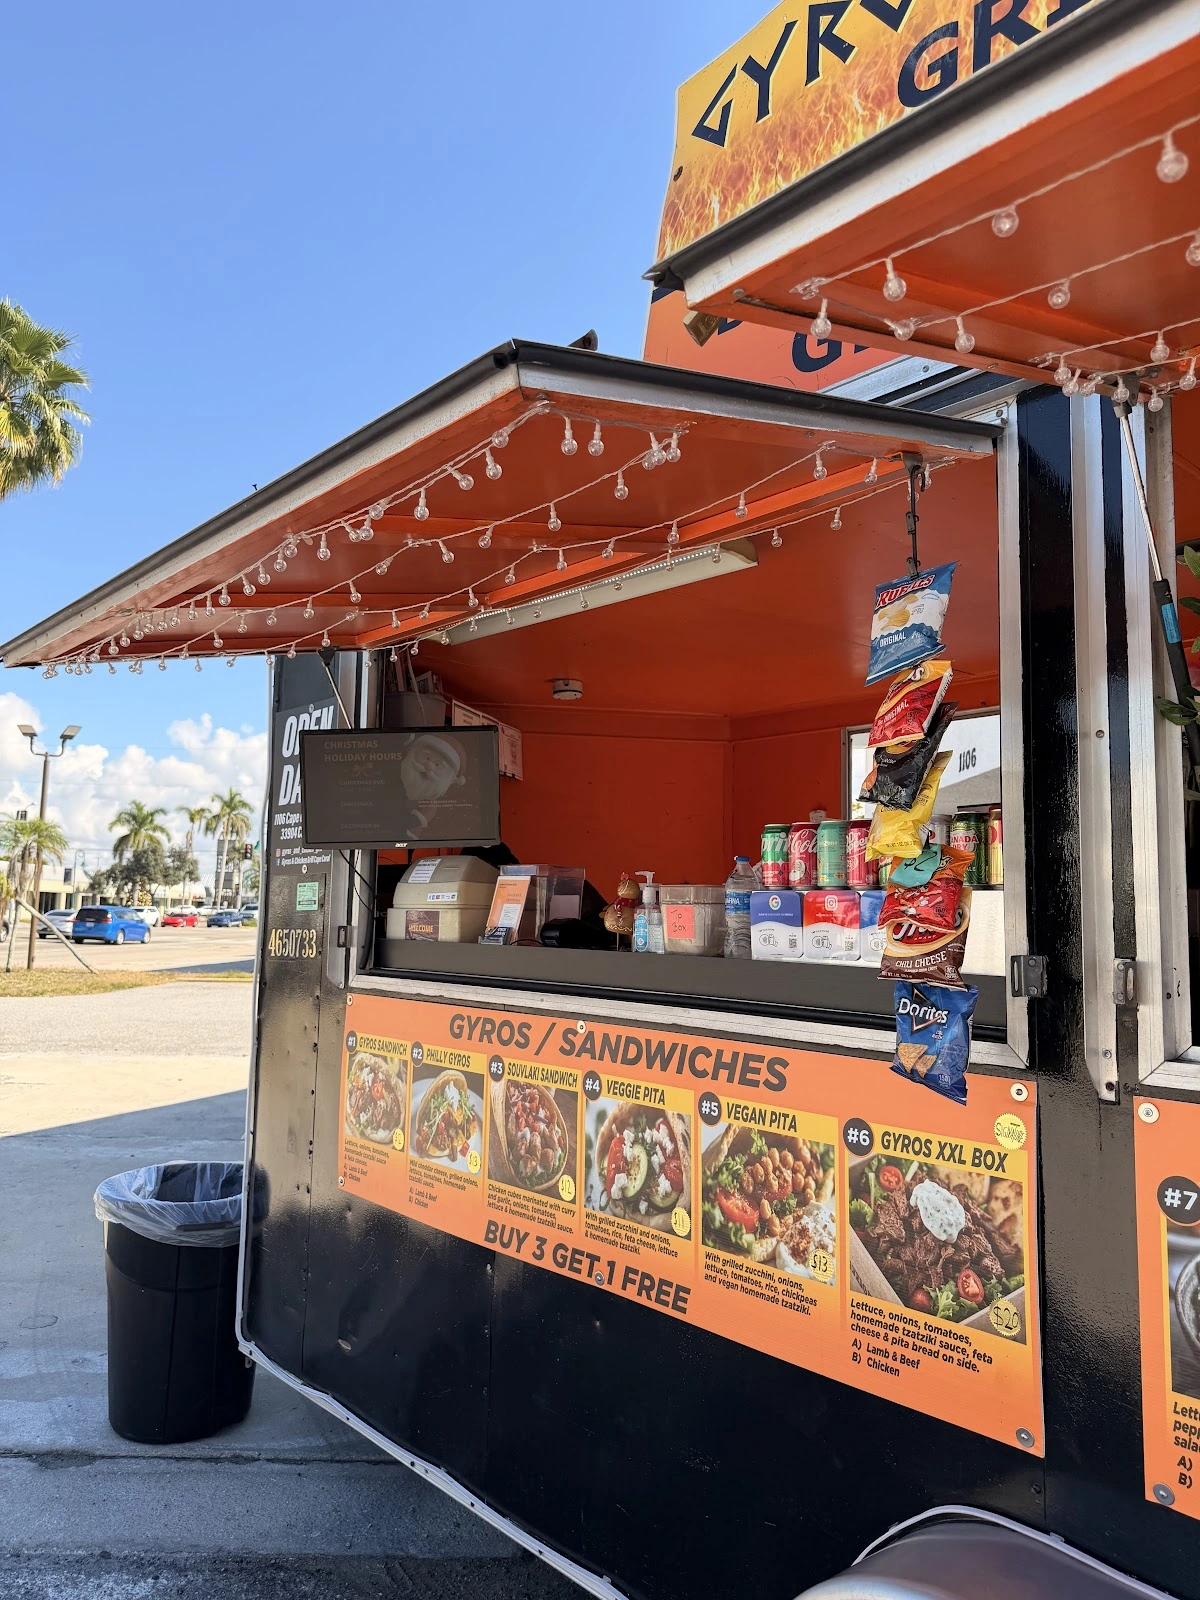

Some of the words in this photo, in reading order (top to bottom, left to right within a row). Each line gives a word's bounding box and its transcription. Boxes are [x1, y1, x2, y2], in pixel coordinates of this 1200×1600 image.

[898, 0, 1093, 108] GR
[879, 632, 906, 647] ORIGINAL
[324, 740, 379, 749] CHRISTMAS
[324, 753, 368, 762] HOLIDAY
[369, 752, 402, 761] HOURS
[959, 747, 977, 773] 1106
[268, 928, 317, 958] 4650733
[896, 959, 913, 968] CHILI
[915, 951, 947, 968] CHEESE
[899, 998, 948, 1023] Doritos
[348, 1036, 356, 1047] #1
[359, 1036, 377, 1050] GYROS
[377, 1040, 408, 1056] SANDWICH
[412, 1048, 423, 1060] #2
[426, 1048, 448, 1063] PHILLY
[448, 1053, 471, 1068] GYROS
[449, 1013, 532, 1049] GYROS
[533, 1022, 556, 1055] /
[558, 1027, 790, 1092] SANDWICHES
[490, 1061, 503, 1075] #3
[507, 1062, 540, 1080] SOUVLAKI
[540, 1068, 578, 1088] SANDWICH
[585, 1077, 600, 1092] #4
[606, 1079, 641, 1100] VEGGIE
[642, 1086, 666, 1105] PITA
[701, 1098, 719, 1117] #5
[726, 1101, 768, 1128] VEGAN
[769, 1110, 798, 1133] PITA
[847, 1127, 870, 1146] #6
[880, 1130, 933, 1159] GYROS
[935, 1139, 967, 1165] XXL
[971, 1147, 1009, 1173] BOX
[409, 1160, 417, 1169] Mild
[448, 1171, 463, 1183] grilled
[463, 1177, 479, 1188] onions,
[409, 1166, 423, 1178] lettuce,
[424, 1172, 443, 1185] tomatoes,
[443, 1178, 466, 1191] homemade
[560, 1178, 573, 1195] $12
[414, 1198, 428, 1208] Chicken
[415, 1188, 425, 1198] Lamb
[428, 1193, 438, 1203] Beef
[488, 1183, 507, 1195] Chicken
[507, 1189, 521, 1200] cubes
[522, 1194, 549, 1208] marinated
[549, 1202, 561, 1212] with
[561, 1207, 576, 1217] curry
[488, 1192, 498, 1200] and
[498, 1196, 511, 1206] garlic,
[512, 1200, 530, 1212] onions,
[531, 1205, 557, 1220] tomatoes,
[1164, 1187, 1198, 1211] #7
[487, 1200, 503, 1212] lettuce
[508, 1206, 536, 1222] homemade
[537, 1215, 556, 1228] tzatziki
[557, 1223, 574, 1234] sauce.
[585, 1211, 598, 1222] With
[598, 1215, 616, 1227] grilled
[616, 1222, 639, 1235] zucchini
[639, 1229, 651, 1239] and
[651, 1233, 671, 1247] onions,
[585, 1221, 611, 1236] tomatoes,
[611, 1229, 623, 1240] rice,
[624, 1233, 636, 1244] feta
[636, 1238, 657, 1252] cheese,
[657, 1244, 679, 1258] lettuce
[589, 1232, 619, 1248] homemade
[619, 1242, 641, 1255] tzatziki.
[484, 1219, 530, 1254] BUY
[532, 1235, 548, 1261] 3
[552, 1242, 601, 1278] GET
[606, 1260, 616, 1286] 1
[621, 1265, 692, 1315] FREE
[705, 1251, 721, 1263] With
[721, 1257, 745, 1271] grilled
[745, 1265, 776, 1283] zucchini,
[777, 1275, 804, 1293] onions,
[811, 1253, 828, 1273] $13
[704, 1261, 729, 1278] lettuce,
[730, 1270, 764, 1290] tomatoes,
[765, 1282, 780, 1295] rice,
[781, 1287, 818, 1307] chickpeas
[704, 1272, 717, 1283] and
[718, 1278, 739, 1291] vegan
[740, 1283, 780, 1305] homemade
[781, 1298, 811, 1316] tzatziki.
[850, 1298, 886, 1319] Lettuce,
[888, 1311, 921, 1331] onions,
[923, 1321, 972, 1347] tomatoes,
[993, 1305, 1019, 1331] $20
[850, 1309, 900, 1334] homemade
[901, 1325, 937, 1346] tzatziki
[939, 1339, 970, 1358] sauce,
[972, 1349, 993, 1365] feta
[850, 1322, 881, 1340] cheese
[882, 1332, 889, 1342] &
[890, 1336, 910, 1349] pita
[911, 1341, 940, 1359] bread
[942, 1353, 954, 1364] on
[956, 1357, 980, 1373] side.
[852, 1338, 862, 1350] A)
[866, 1343, 890, 1359] Lamb
[891, 1352, 898, 1361] &
[899, 1353, 921, 1370] Beef
[852, 1352, 862, 1365] B)
[866, 1357, 900, 1377] Chicken
[1173, 1401, 1200, 1422] Lett
[1173, 1435, 1200, 1454] sala
[1177, 1455, 1193, 1471] A)
[1178, 1472, 1193, 1489] B)
